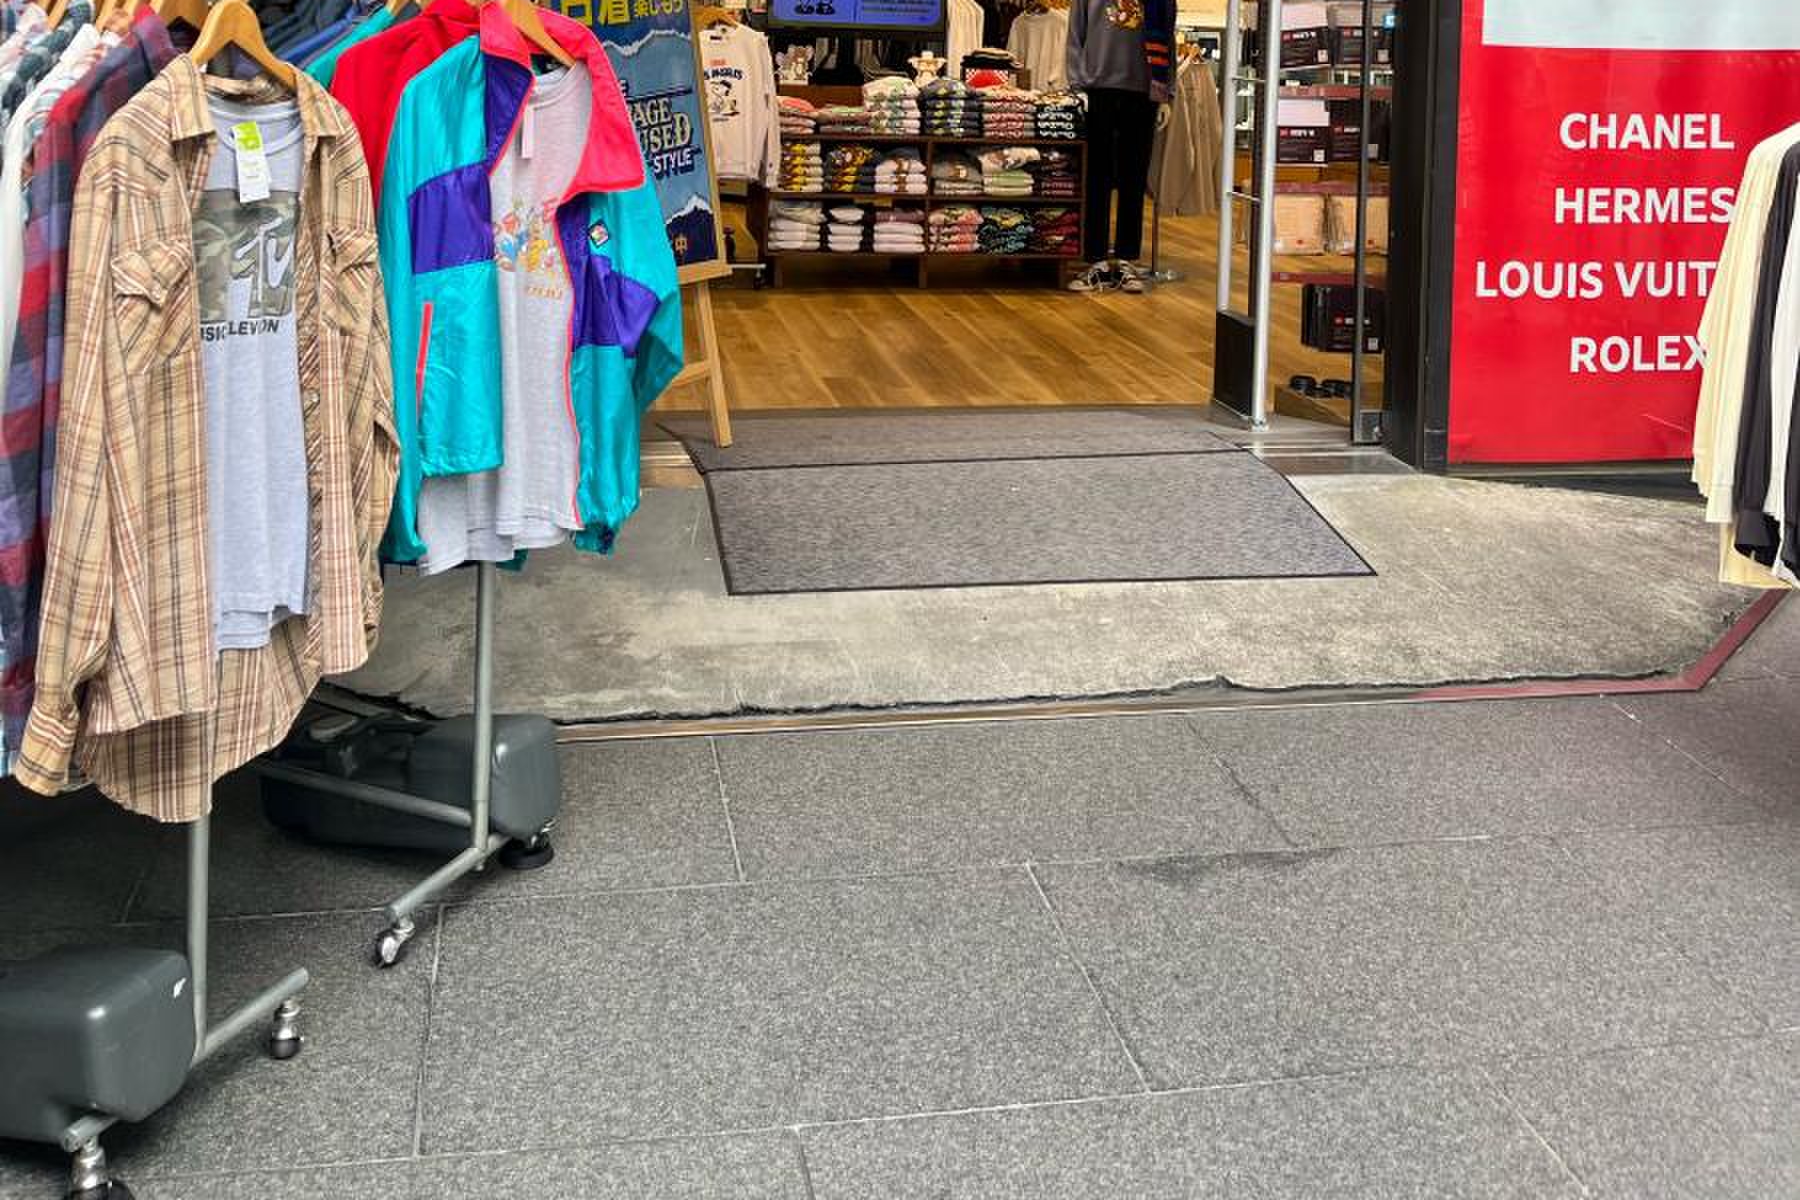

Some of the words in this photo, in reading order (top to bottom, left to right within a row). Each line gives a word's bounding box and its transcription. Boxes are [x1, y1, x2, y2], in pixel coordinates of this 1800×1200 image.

[628, 97, 672, 129] AGE
[1559, 112, 1736, 150] CHANEL
[653, 148, 693, 174] STYLE
[1554, 187, 1736, 224] HERMES
[1475, 260, 1604, 299] LOUIS
[1613, 260, 1720, 298] VUIT
[1569, 335, 1709, 373] ROLEX
